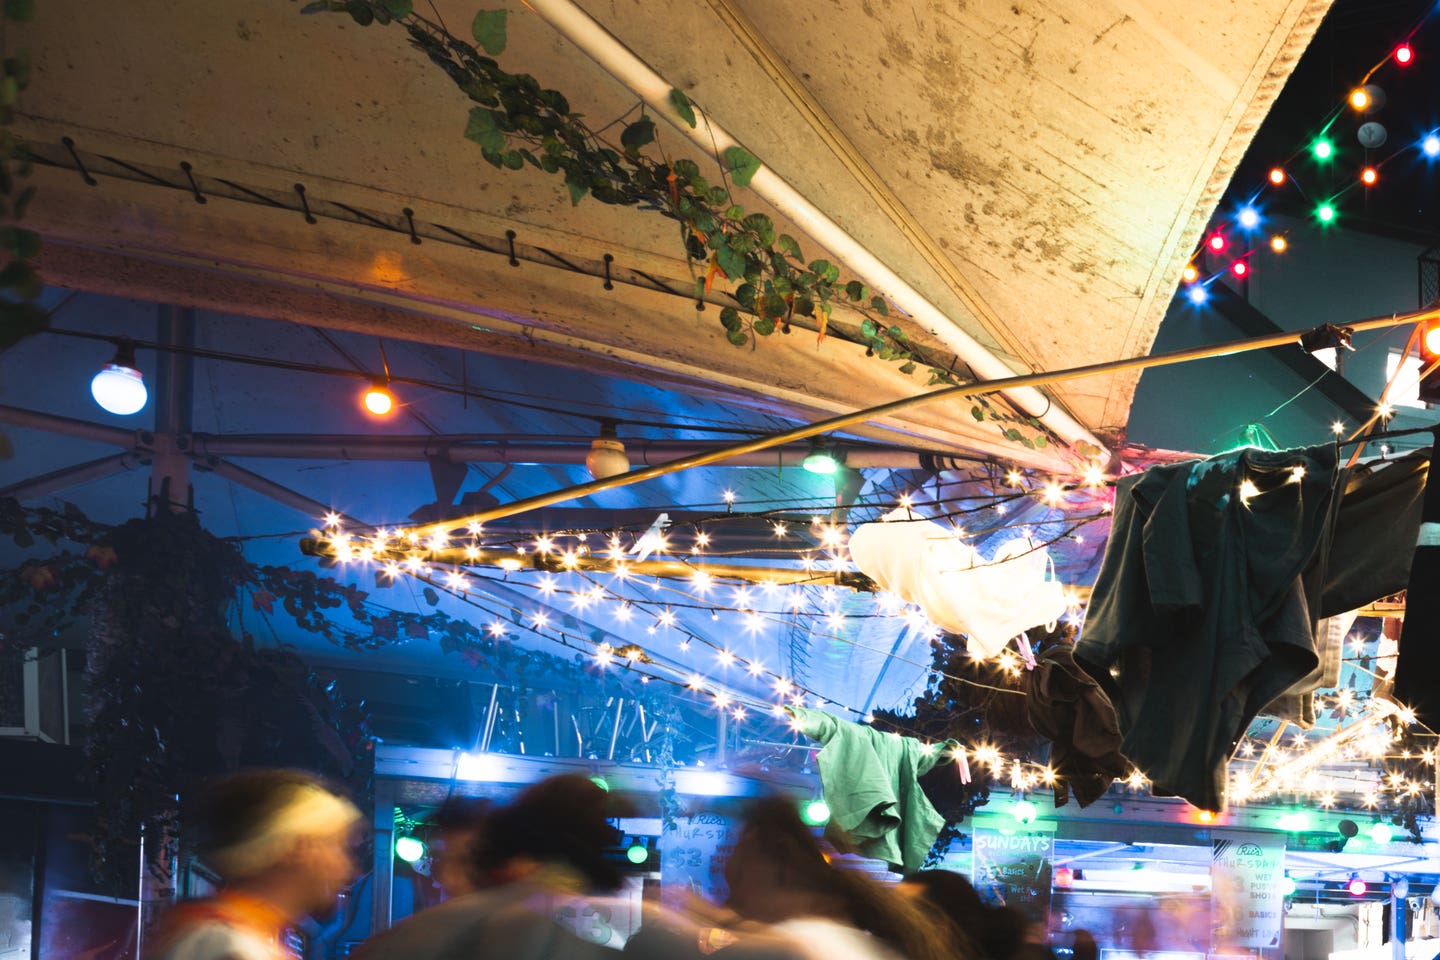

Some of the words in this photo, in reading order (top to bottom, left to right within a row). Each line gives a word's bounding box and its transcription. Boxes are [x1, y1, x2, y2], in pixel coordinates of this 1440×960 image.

[976, 835, 1050, 852] SUNDAYS
[1240, 846, 1261, 856] Ric's
[1002, 866, 1025, 876] Basics
[1255, 873, 1272, 881] WET
